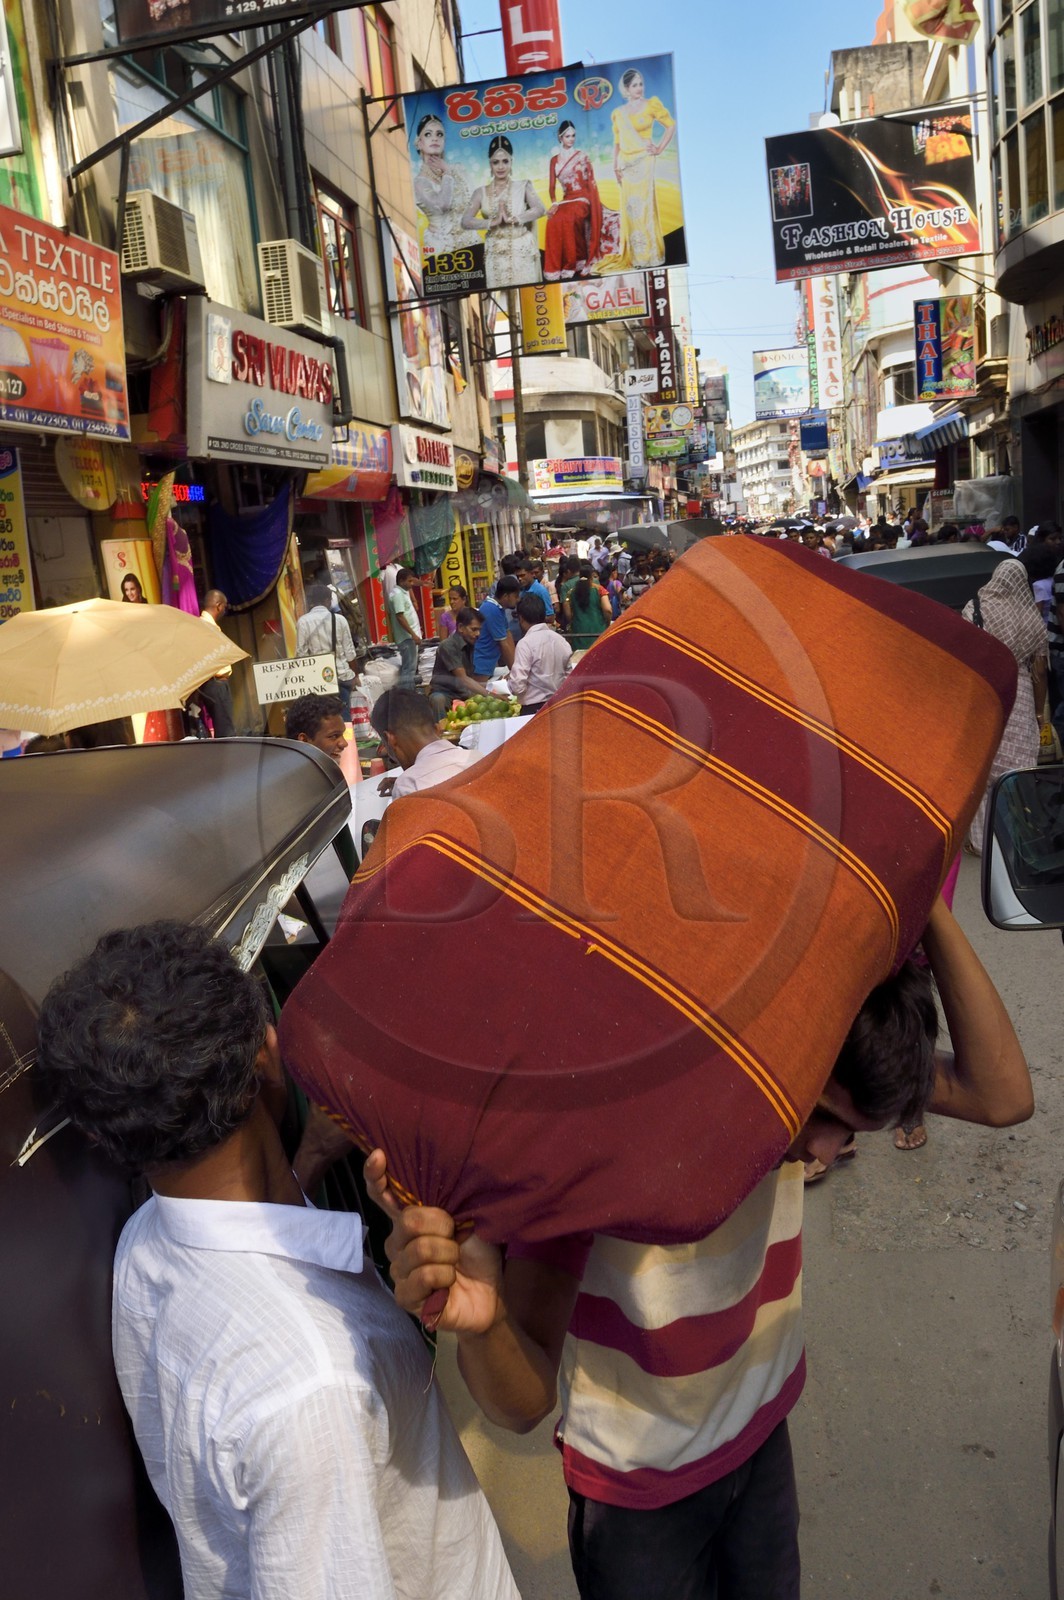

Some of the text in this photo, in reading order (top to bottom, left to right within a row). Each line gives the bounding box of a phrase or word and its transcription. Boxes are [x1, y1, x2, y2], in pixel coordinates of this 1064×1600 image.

[236, 1, 260, 13] 129,
[804, 249, 844, 260] Wholesale
[846, 247, 852, 255] &
[854, 243, 877, 254] Retail
[879, 240, 909, 249] Dealers
[920, 233, 948, 244] Textile
[14, 225, 114, 294] TEXTILE
[424, 250, 474, 276] 133
[585, 287, 644, 310] GAEL
[36, 318, 44, 327] in
[44, 319, 57, 331] Bed
[57, 323, 77, 337] Sheets
[917, 304, 938, 377] THAI
[232, 330, 333, 405] SRI VIJAYAS
[660, 391, 677, 400] 151
[629, 398, 640, 465] MESCO
[553, 461, 582, 473] BEAUTY
[261, 658, 316, 673] RESERVED
[284, 675, 305, 685] FOR
[265, 685, 327, 700] HABIB BANK
